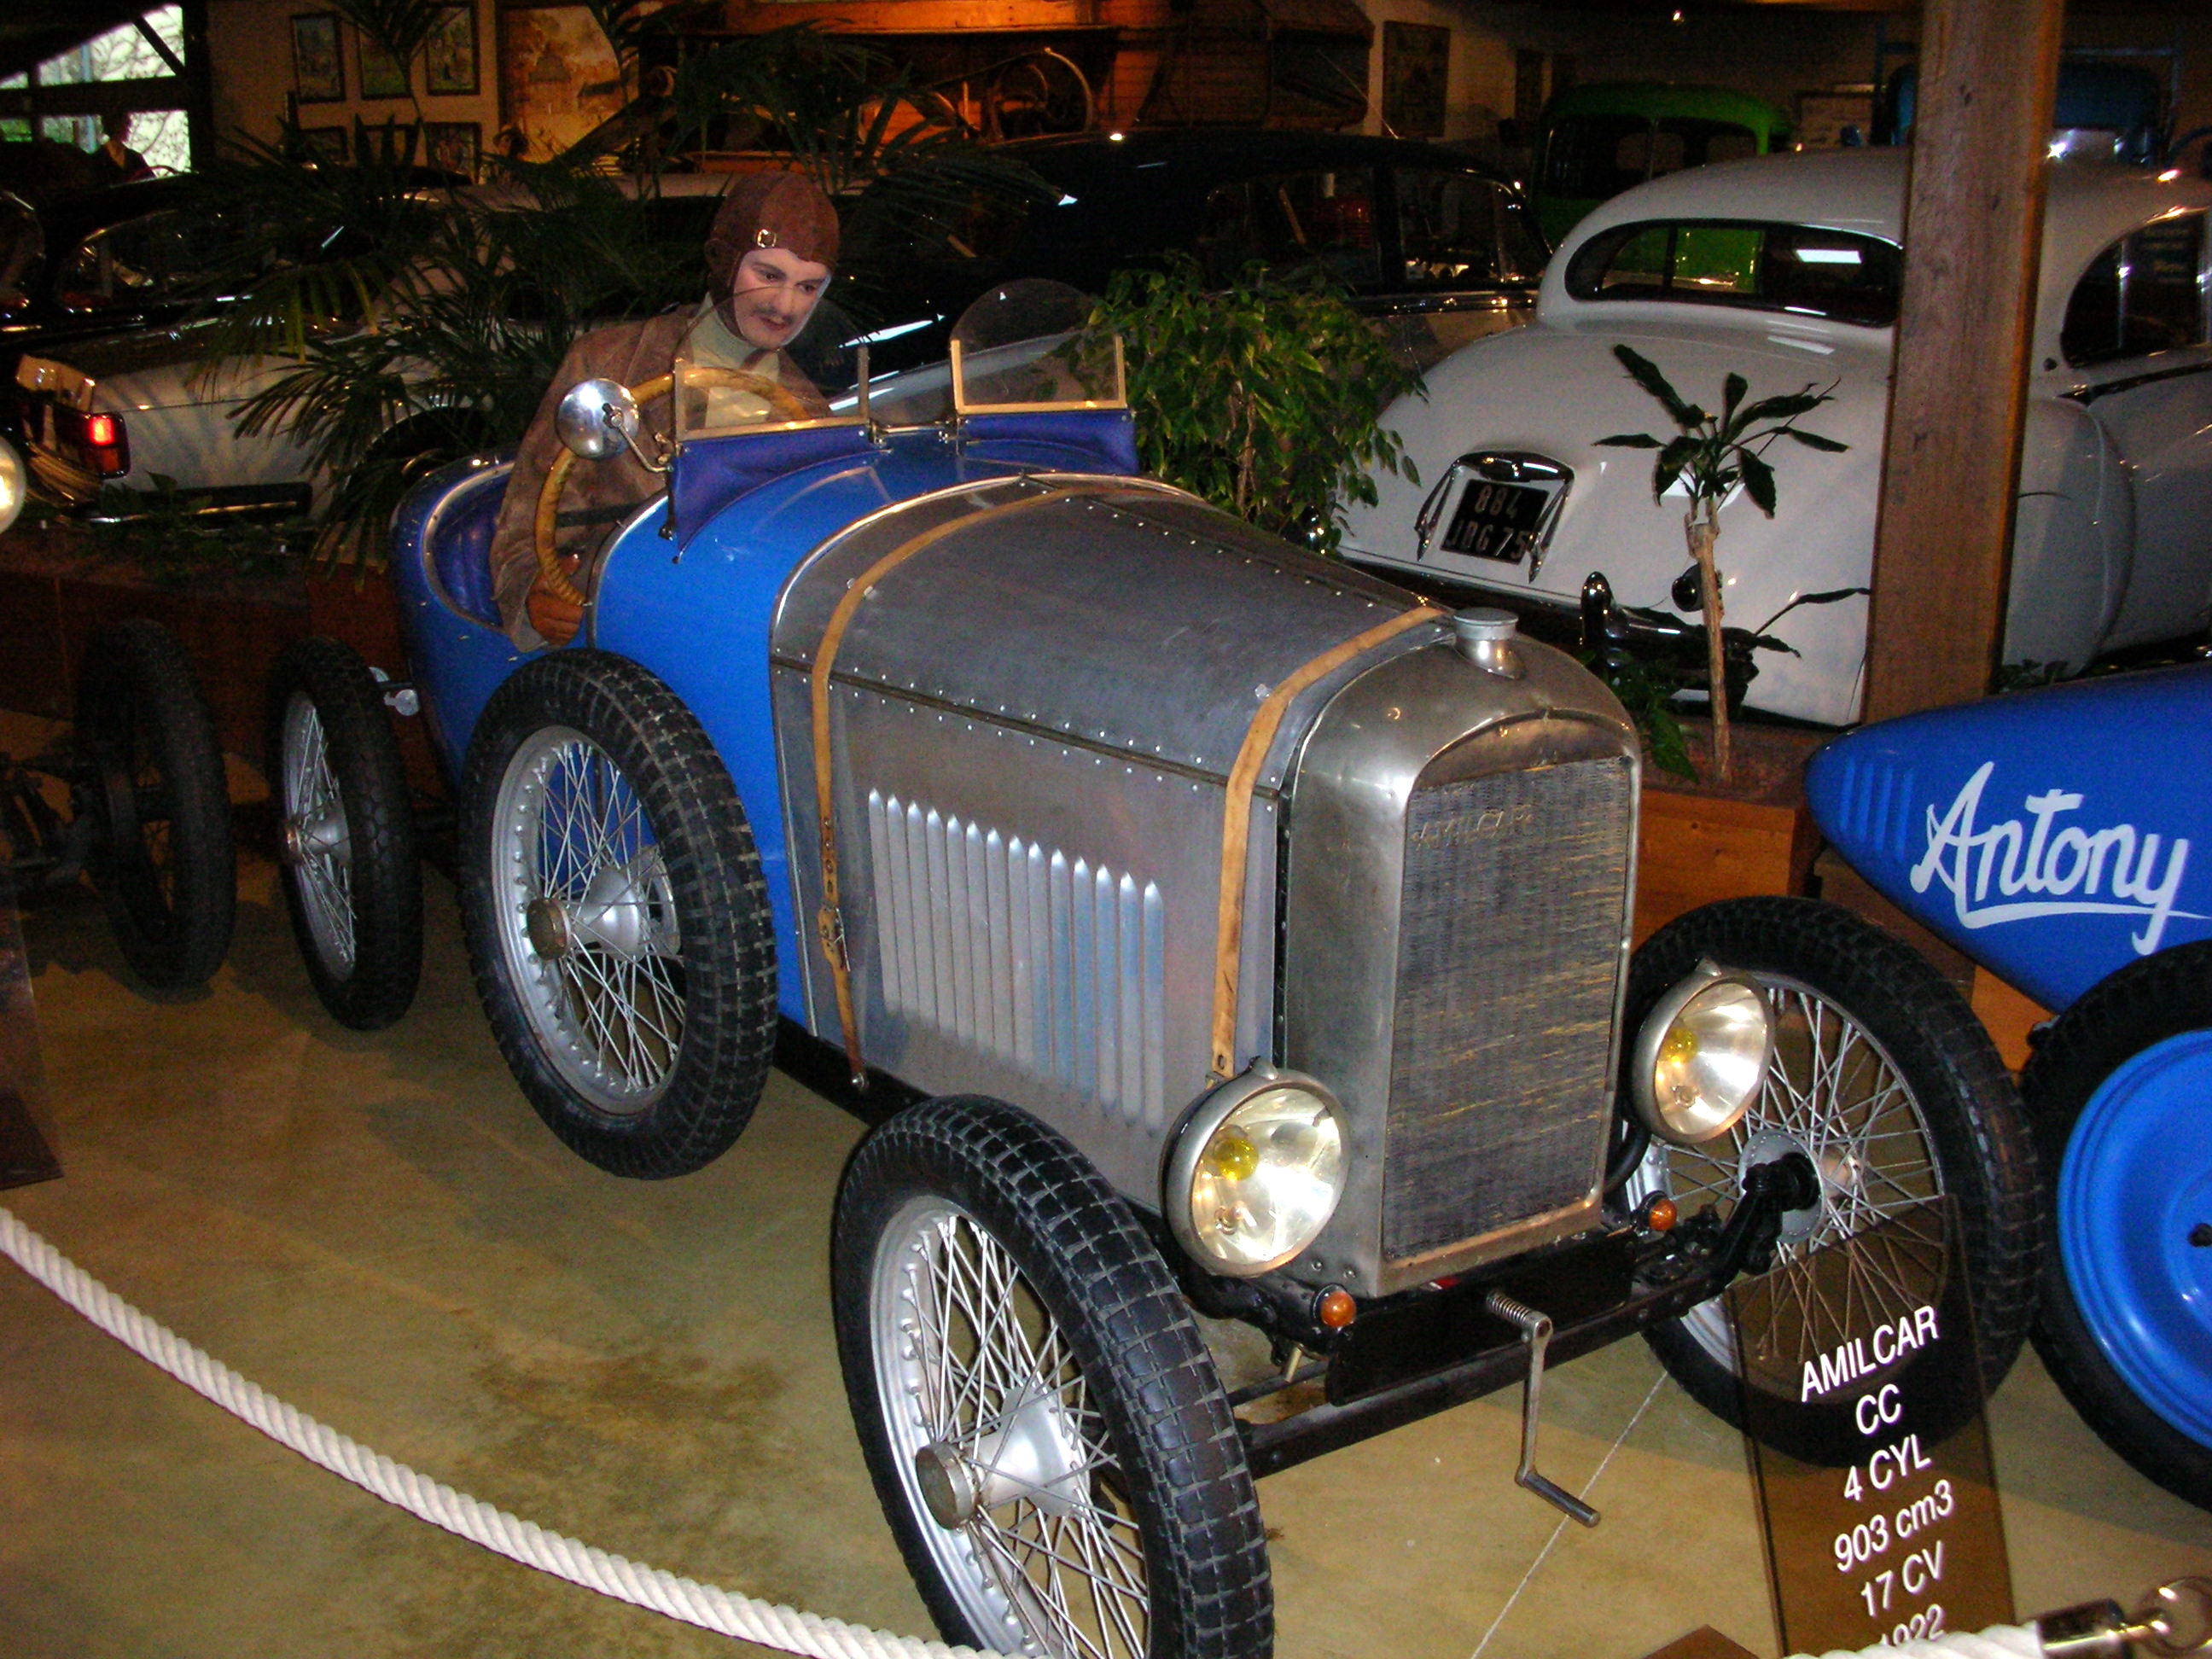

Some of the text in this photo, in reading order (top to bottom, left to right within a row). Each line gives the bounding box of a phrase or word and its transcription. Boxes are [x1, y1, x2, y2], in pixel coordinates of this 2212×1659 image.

[1909, 760, 2193, 956] Antony
[1801, 1304, 1940, 1403] AMILCAR
[1854, 1382, 1902, 1435] CC
[1843, 1433, 1932, 1502] 4 CYL
[1833, 1478, 1954, 1573] 903 cm3
[1860, 1540, 1946, 1618] 17 CV
